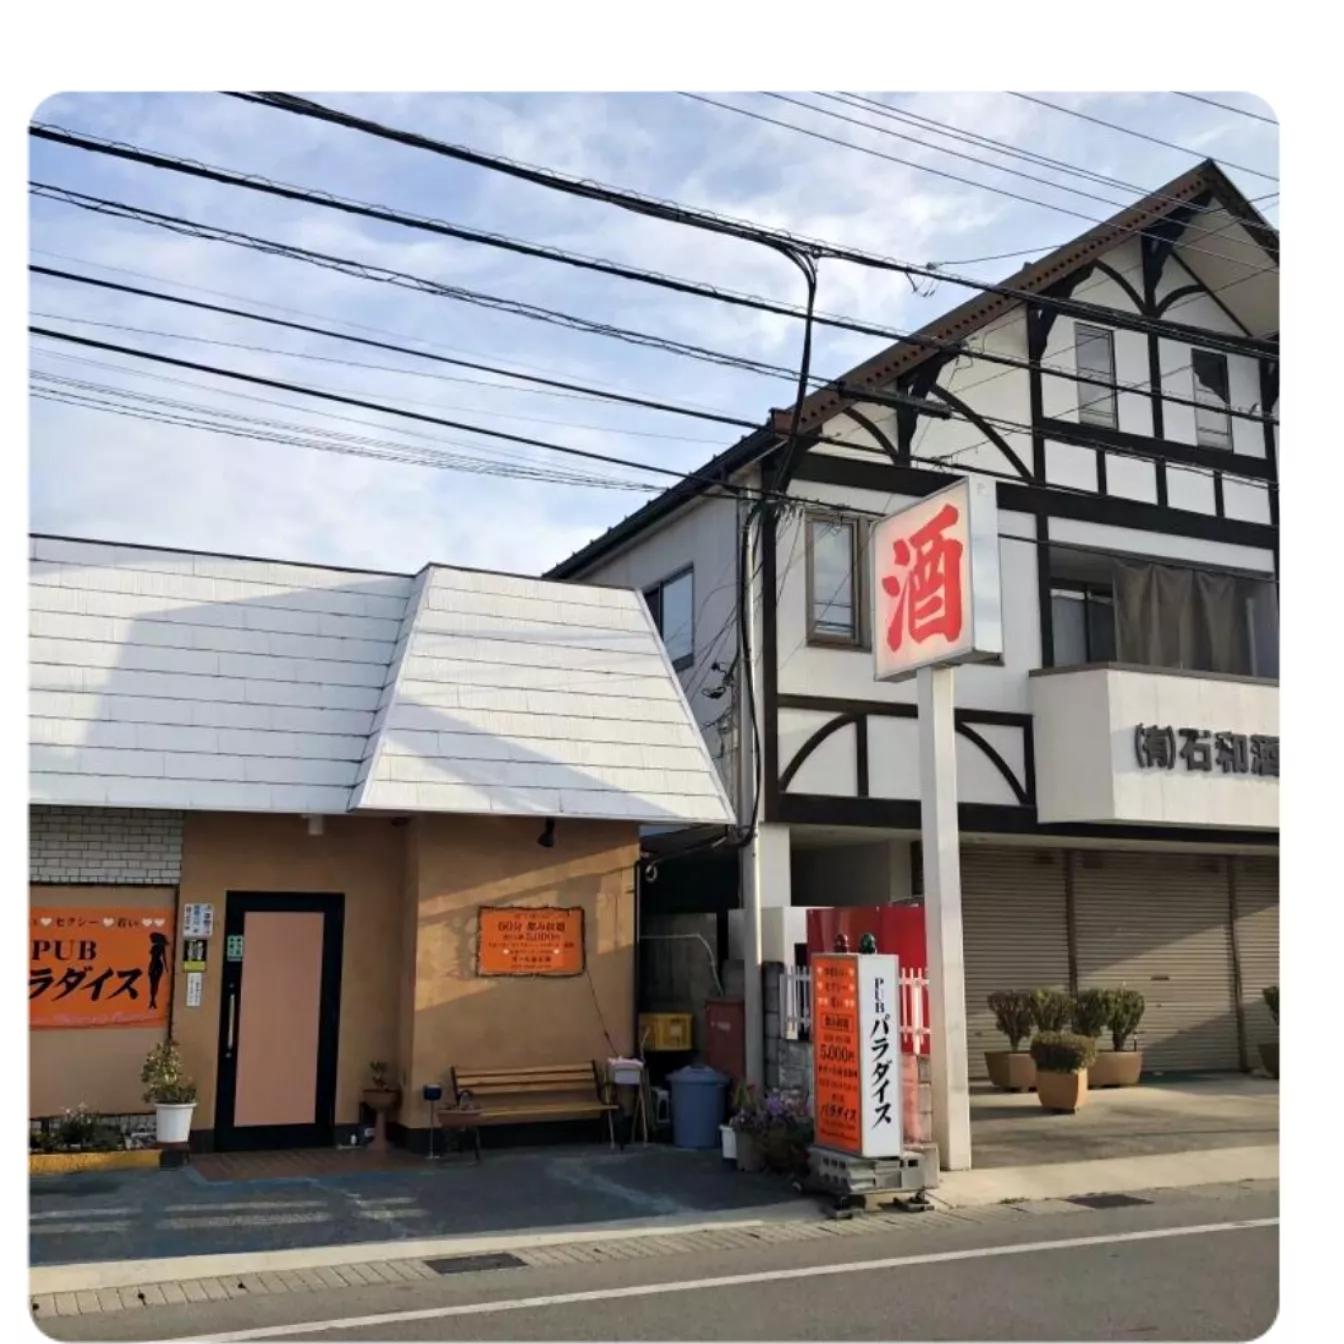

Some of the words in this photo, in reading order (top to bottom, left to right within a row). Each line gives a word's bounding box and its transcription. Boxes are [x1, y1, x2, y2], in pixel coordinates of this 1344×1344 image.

[881, 503, 964, 653] 酒
[31, 939, 98, 961] PUB
[870, 1013, 892, 1129] パラダイス
